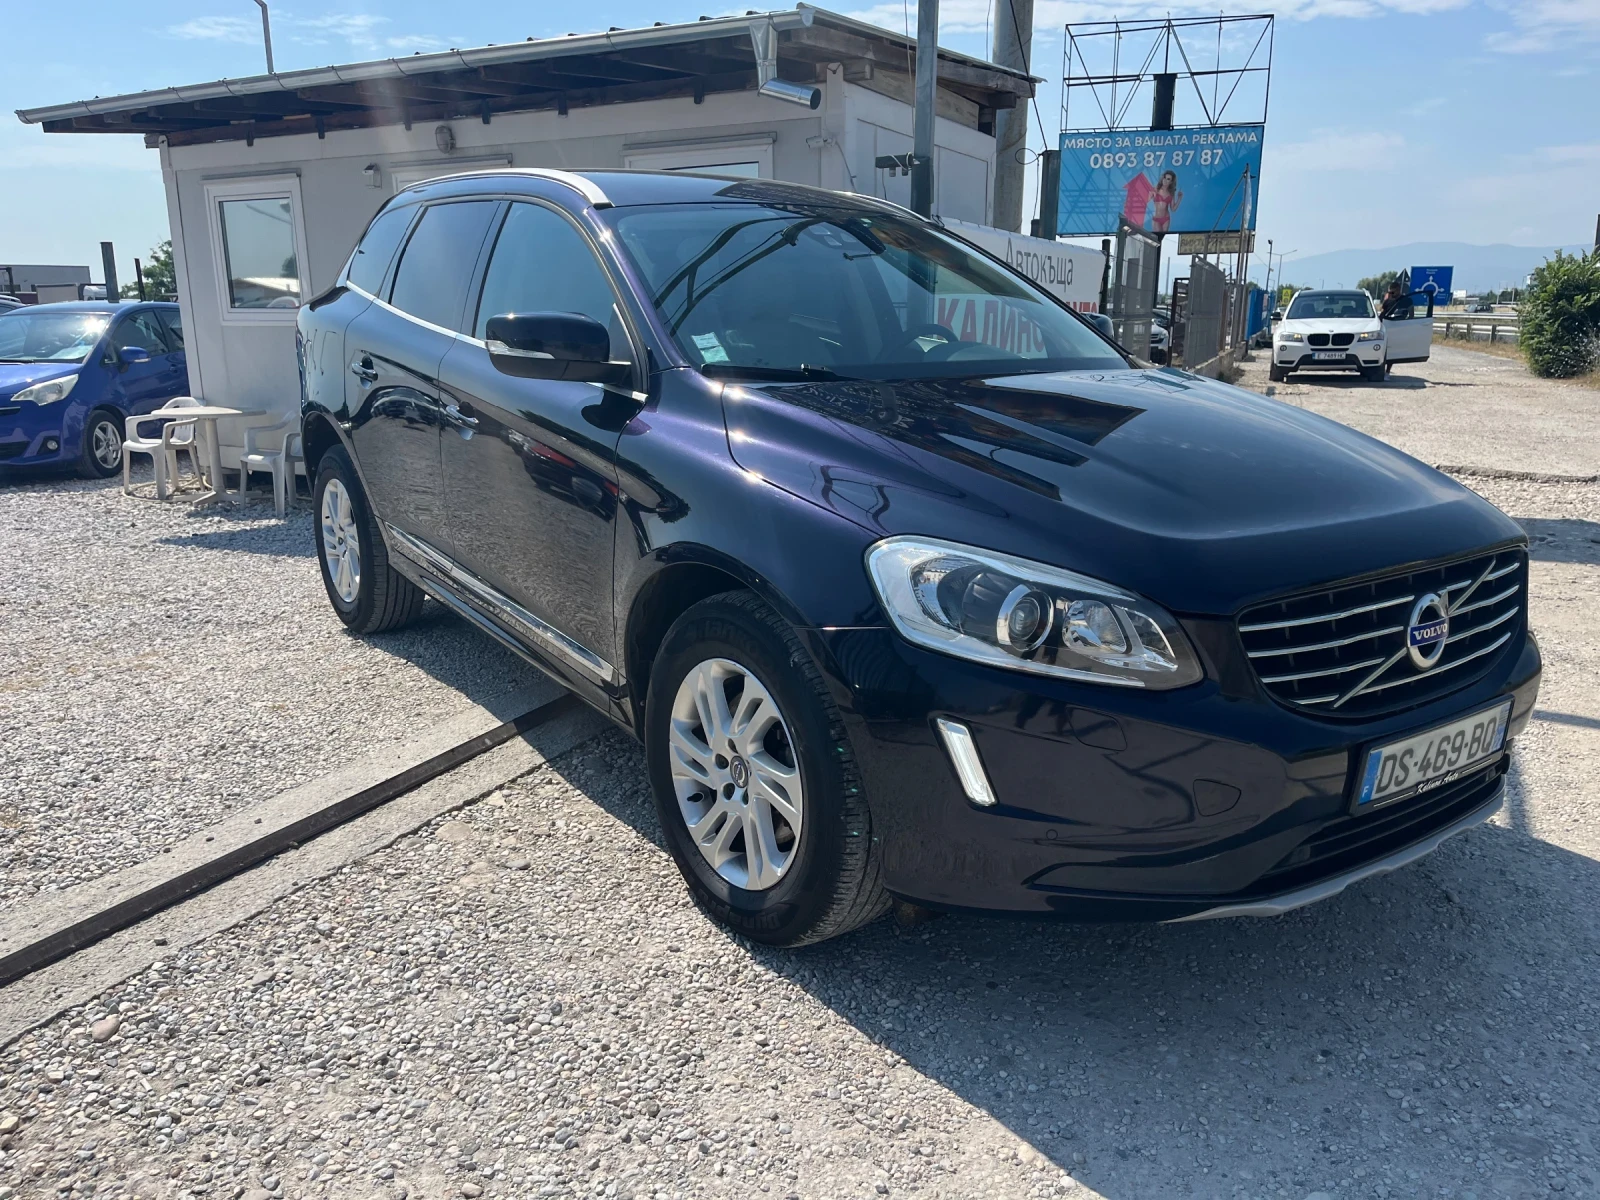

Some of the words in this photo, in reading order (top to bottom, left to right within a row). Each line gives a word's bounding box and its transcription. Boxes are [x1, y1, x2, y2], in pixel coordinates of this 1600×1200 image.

[1064, 138, 1112, 149] МЯСТО
[1115, 136, 1131, 148] ЗА
[1135, 135, 1189, 147] ВАШАТА
[1192, 132, 1257, 145] РЕКЛАМА
[1089, 152, 1137, 169] 0893
[1143, 151, 1167, 167] 87
[1171, 150, 1195, 166] 87
[1200, 149, 1223, 165] 87
[1005, 237, 1074, 293] Автокъща
[1413, 623, 1448, 641] VOLVO
[1362, 786, 1369, 798] F
